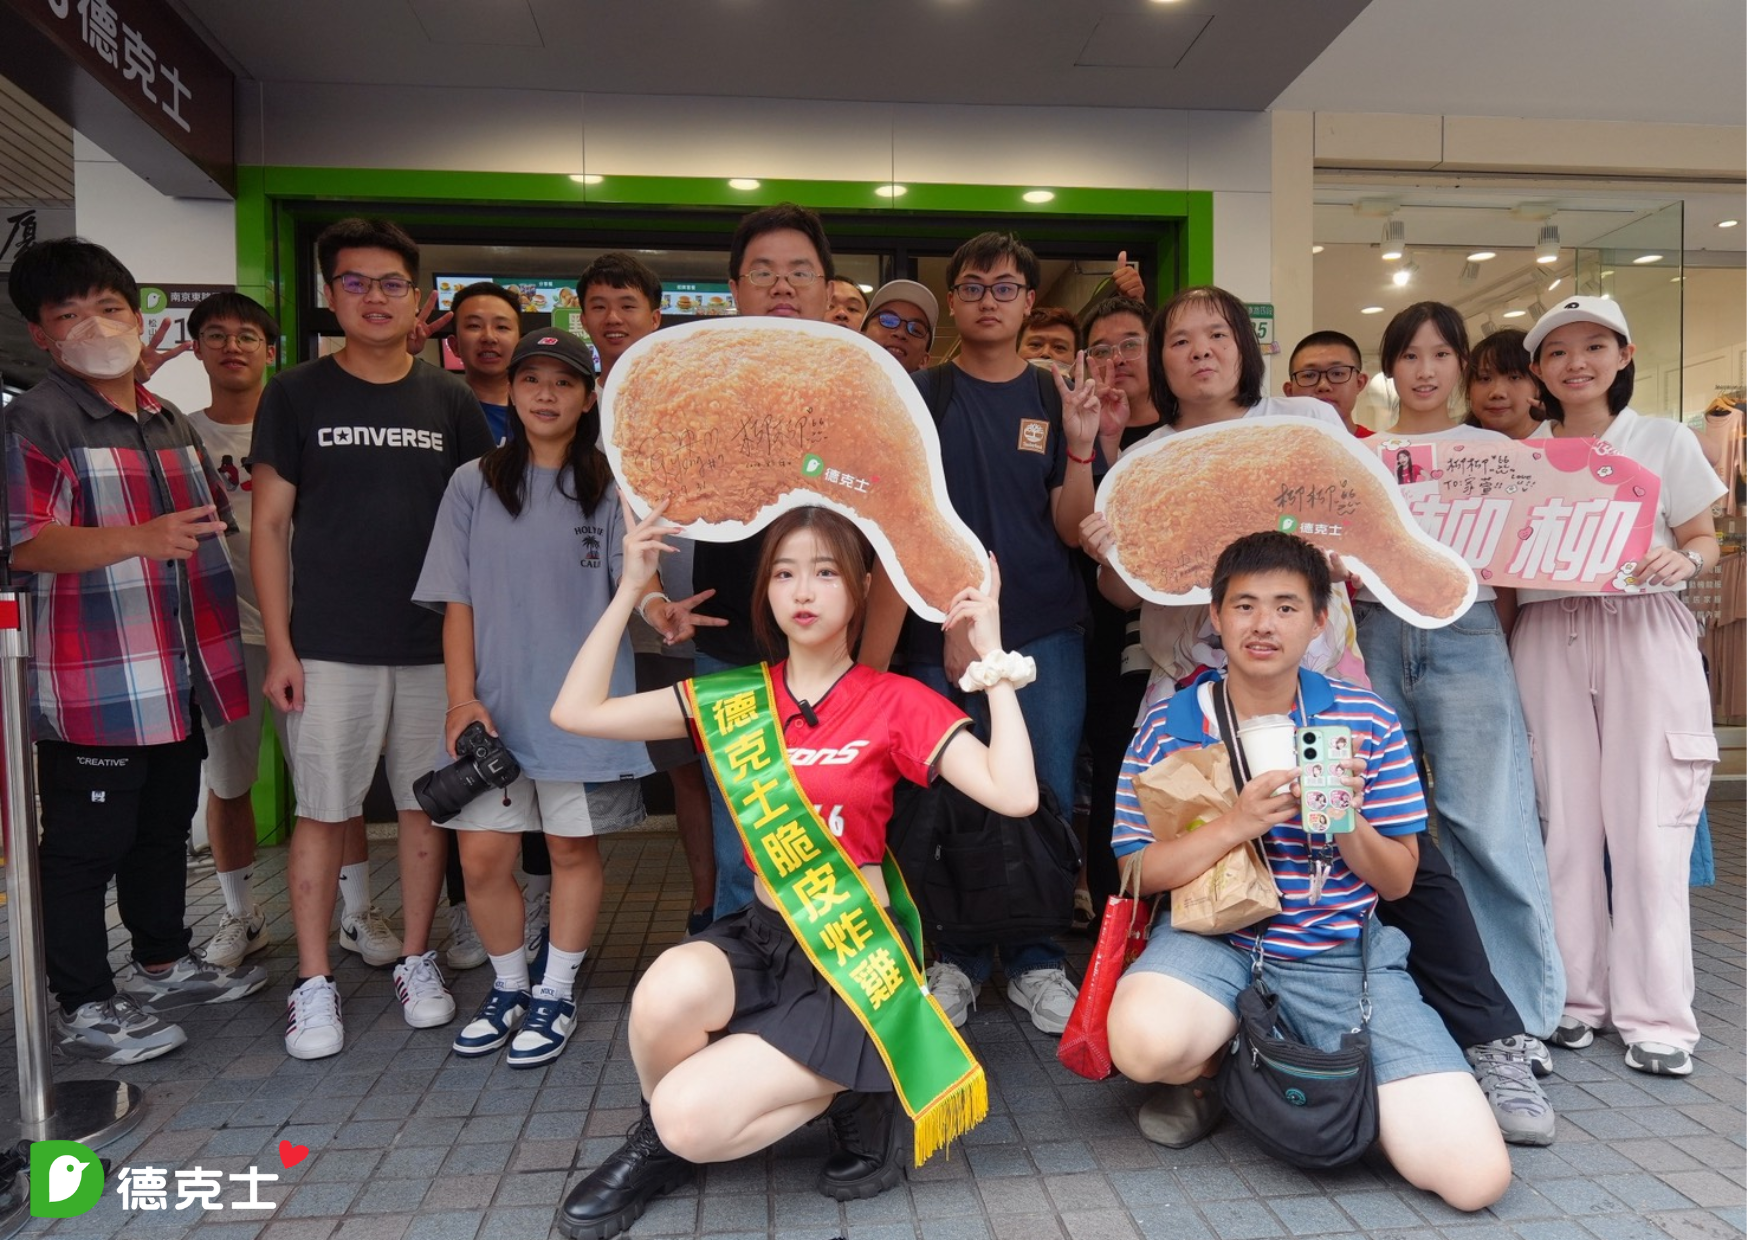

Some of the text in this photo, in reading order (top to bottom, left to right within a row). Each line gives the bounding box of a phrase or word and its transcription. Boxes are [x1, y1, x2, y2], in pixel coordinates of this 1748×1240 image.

[77, 0, 192, 133] 德克士
[317, 426, 444, 451] CONVERSE
[825, 467, 870, 493] 德克士
[1300, 522, 1343, 536] 德克士
[712, 690, 904, 1011] 德克士脆皮炸雞
